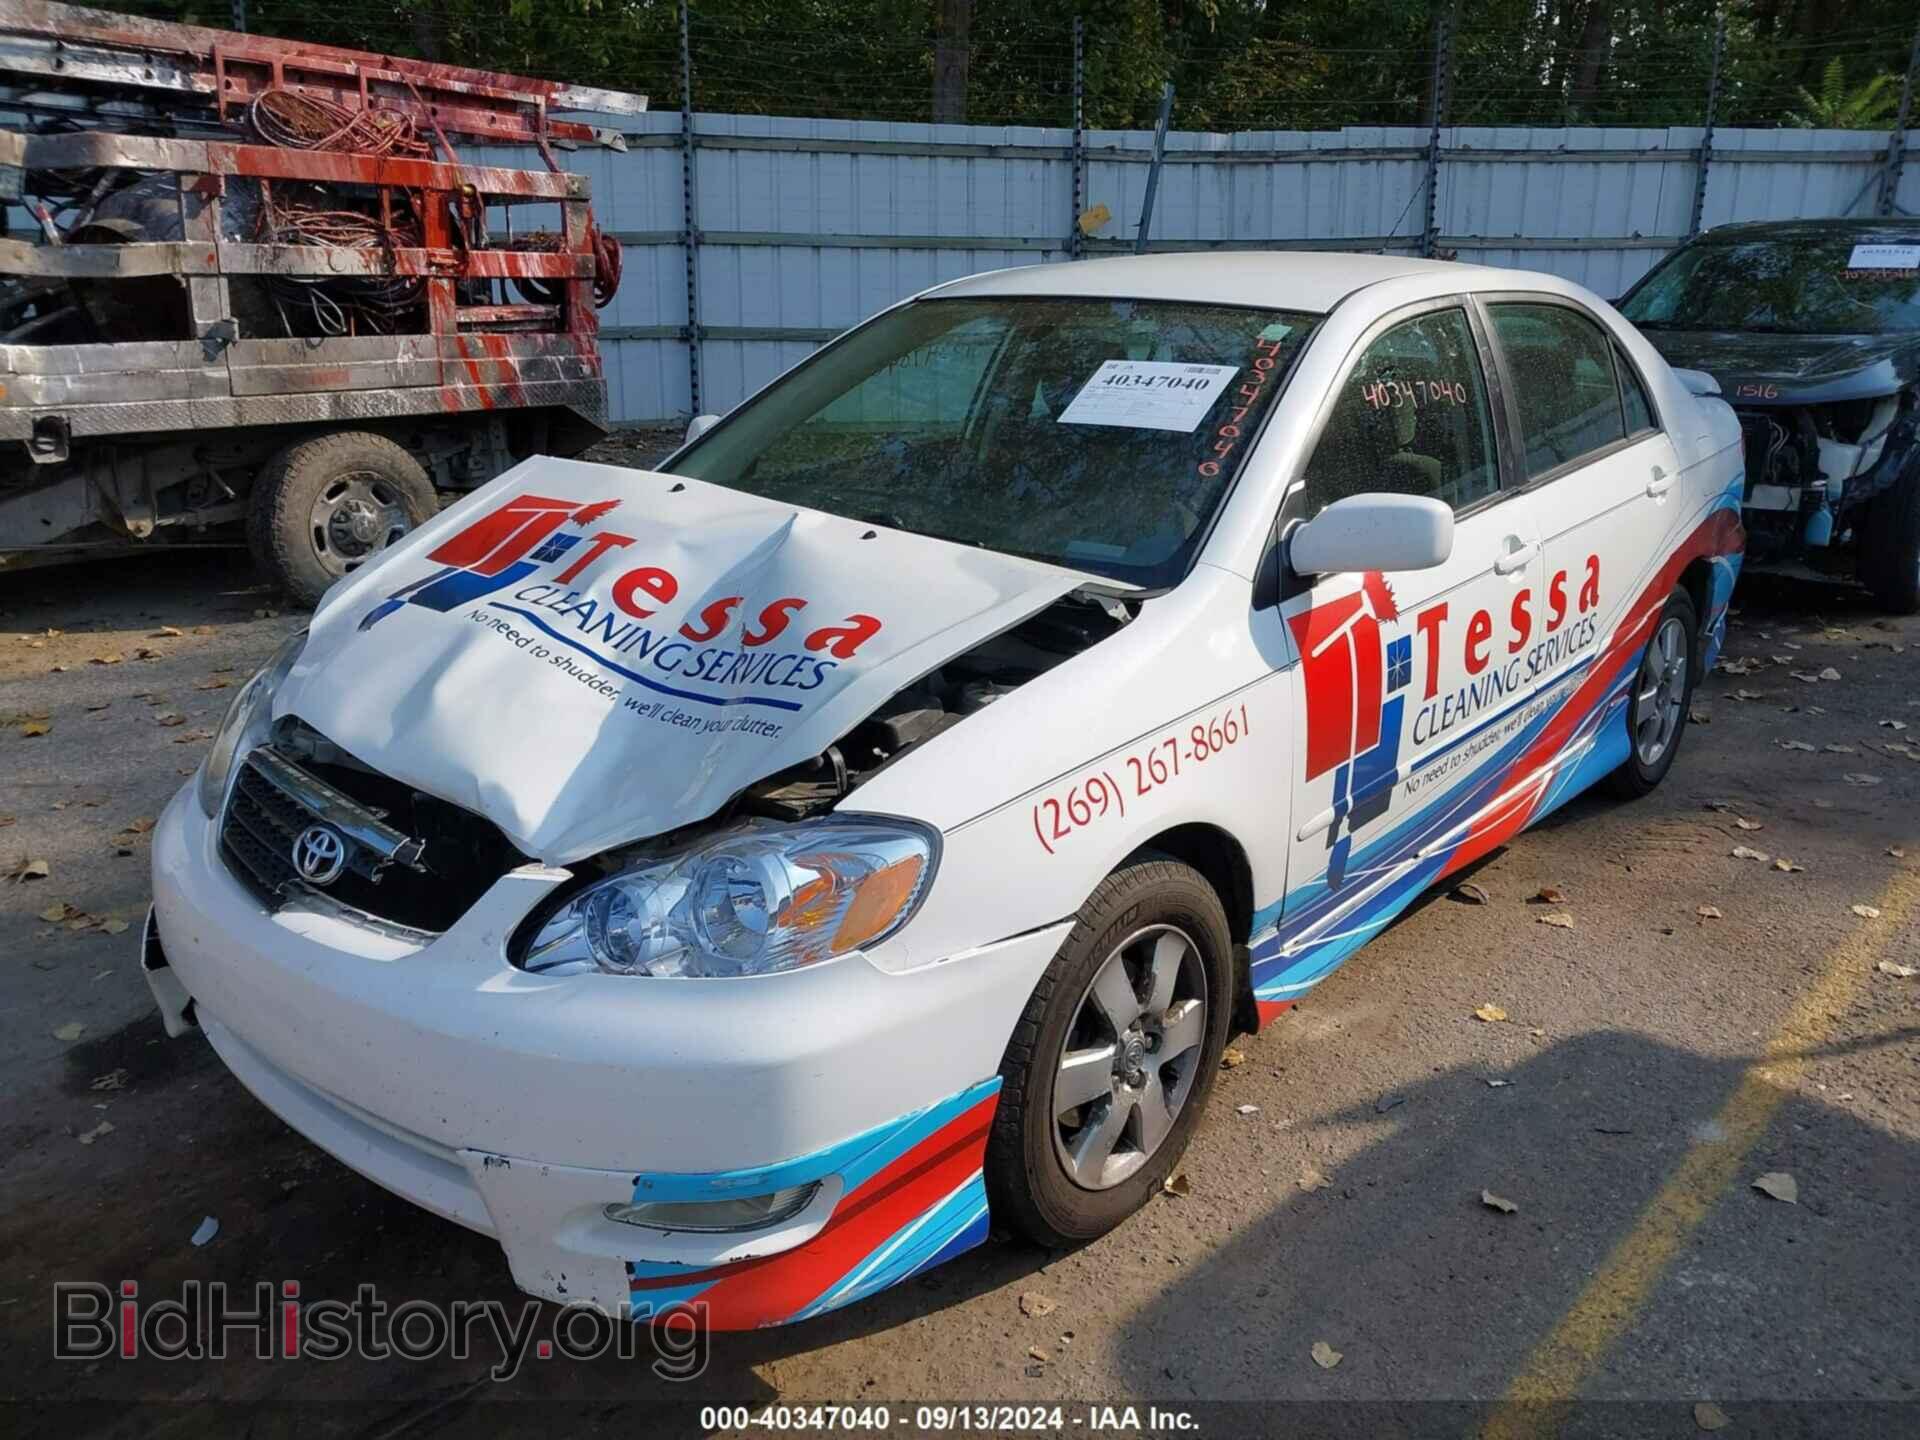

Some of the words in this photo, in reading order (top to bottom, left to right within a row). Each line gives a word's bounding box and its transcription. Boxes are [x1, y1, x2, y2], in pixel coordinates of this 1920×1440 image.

[1103, 374, 1210, 390] 40347040
[1362, 379, 1466, 409] 40347040
[1736, 384, 1778, 399] 1516
[514, 585, 692, 671] CLEANING
[683, 649, 838, 690] SERVICES
[551, 532, 883, 659] Tessa
[1417, 554, 1600, 702] Tessa
[464, 609, 488, 623] No
[486, 617, 535, 649] need
[529, 643, 550, 659] to
[549, 655, 622, 701] shudder,
[624, 697, 664, 719] we'll
[661, 707, 702, 731] clean
[696, 718, 733, 735] your
[1413, 658, 1520, 746] CLEANING
[1524, 612, 1597, 684] SERVICES
[1034, 772, 1124, 854] (269)
[1127, 704, 1249, 796] 267-8661
[1403, 776, 1421, 798] No
[1422, 757, 1449, 787] need
[1450, 753, 1462, 769] to
